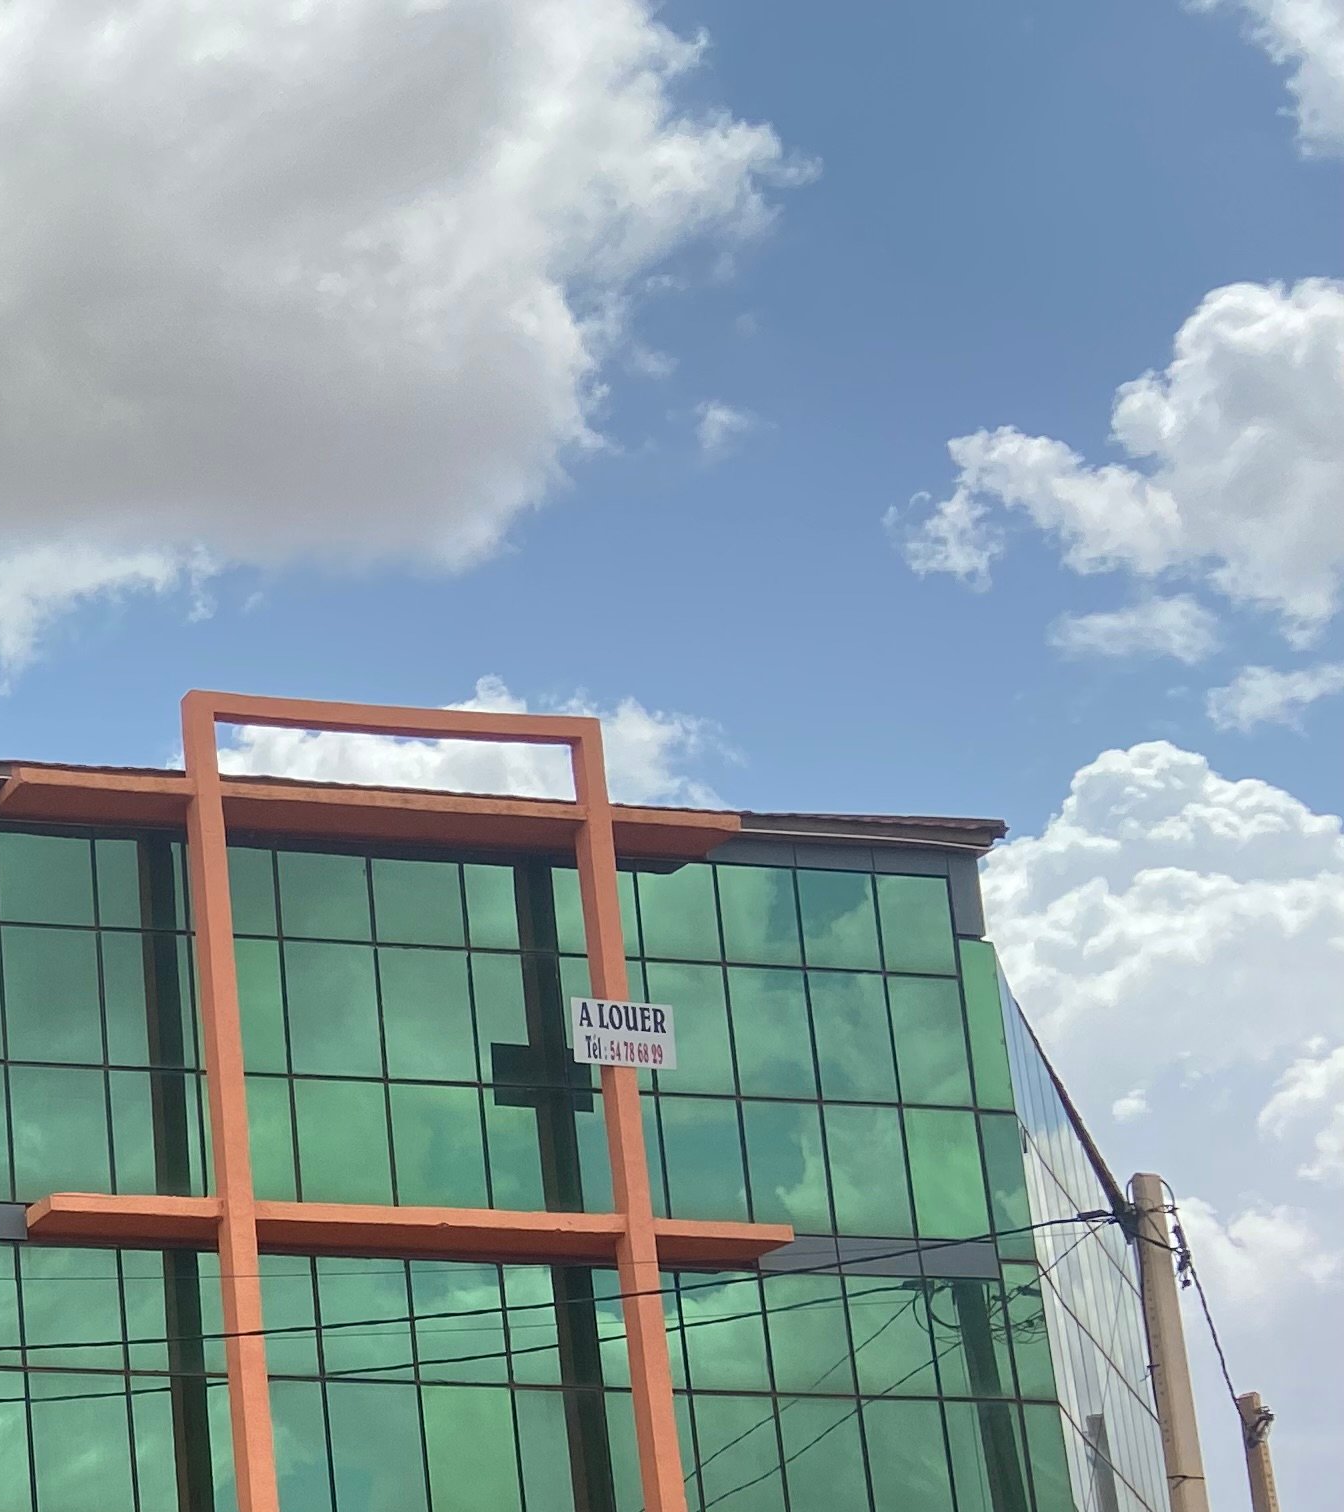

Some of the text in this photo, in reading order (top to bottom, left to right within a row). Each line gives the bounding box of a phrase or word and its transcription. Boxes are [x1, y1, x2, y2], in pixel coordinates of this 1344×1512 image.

[579, 1002, 666, 1034] A LOUER
[610, 1040, 621, 1061] 54
[623, 1041, 634, 1062] 78
[637, 1042, 649, 1063] 68
[651, 1043, 663, 1065] 29
